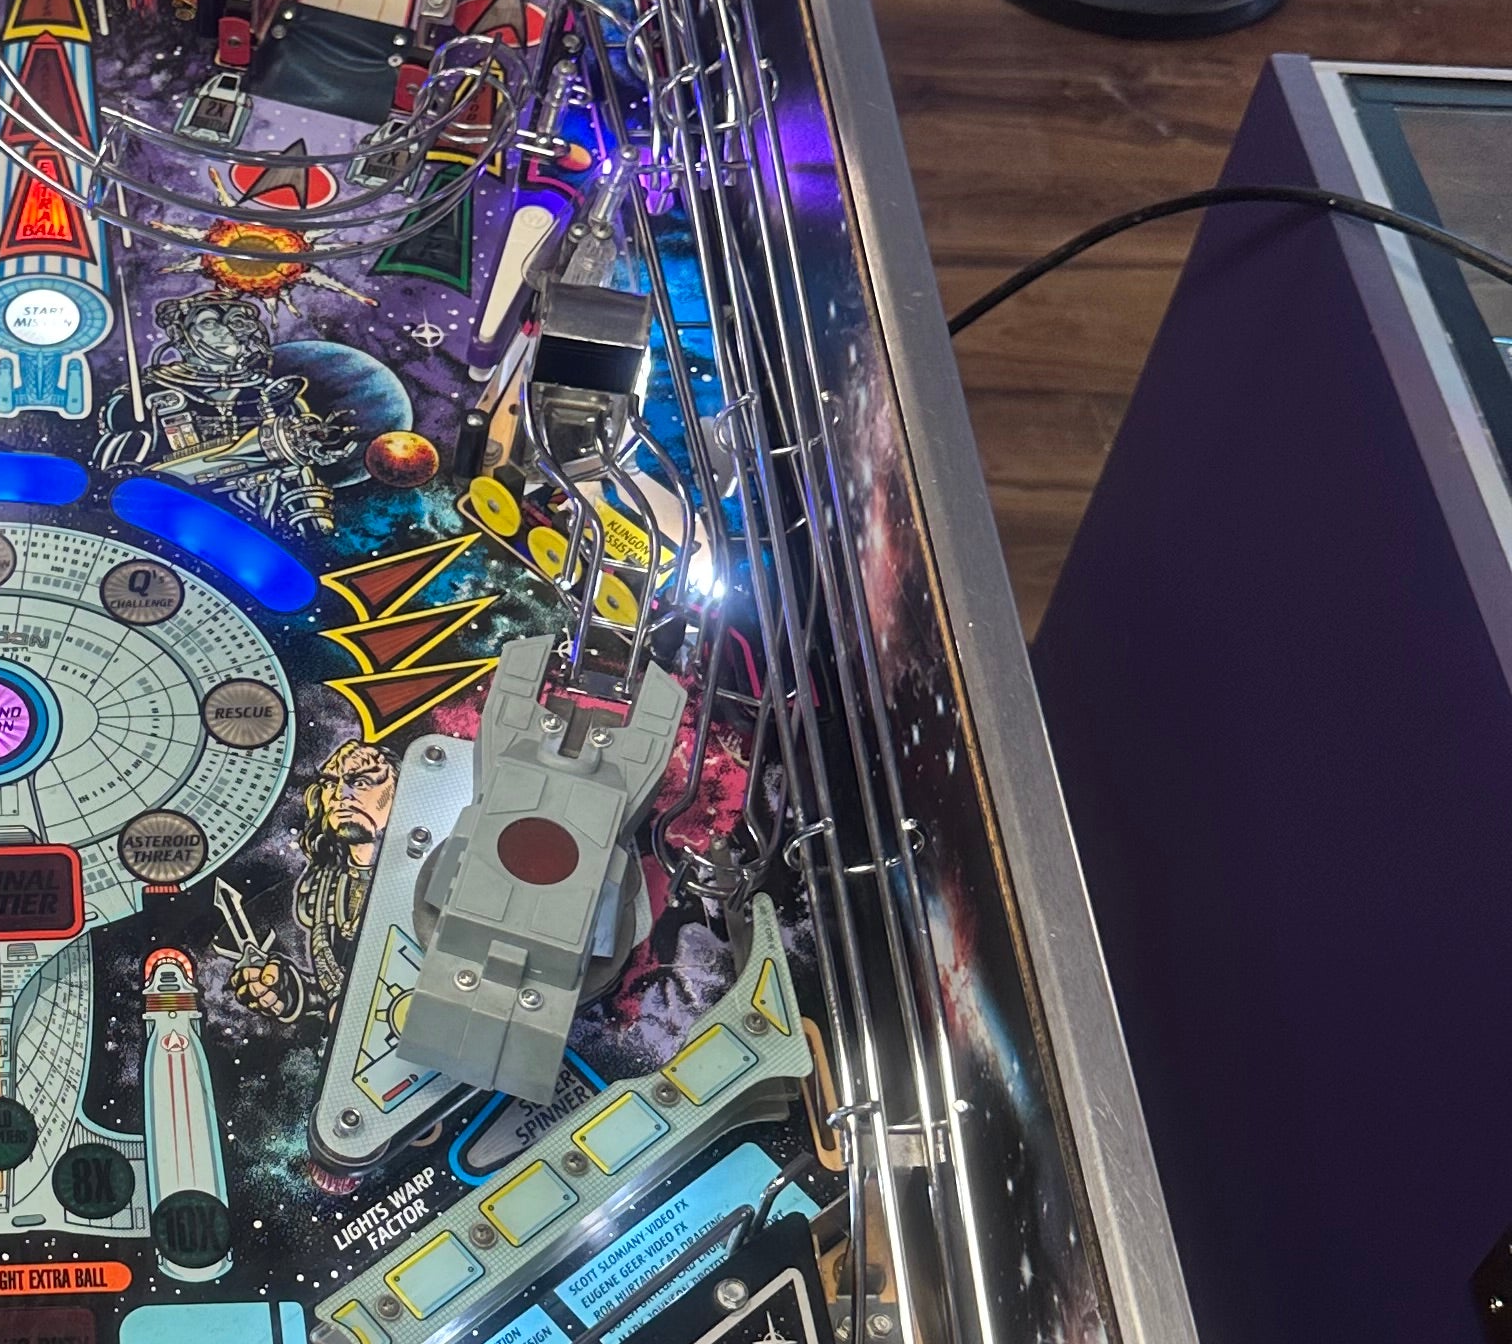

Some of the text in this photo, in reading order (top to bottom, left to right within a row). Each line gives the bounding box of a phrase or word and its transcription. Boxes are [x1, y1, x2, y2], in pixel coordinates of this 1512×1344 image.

[22, 224, 66, 237] BALL
[109, 596, 175, 610] CHALLENGE
[214, 704, 274, 720] RESCUE
[123, 833, 201, 849] ASTEROID
[131, 848, 196, 865] THREAT
[516, 1087, 590, 1146] SPINNER
[71, 1157, 116, 1203] 8X
[333, 1166, 436, 1252] LIGHTS WARP
[367, 1198, 429, 1251] FACTOR
[166, 1204, 224, 1254] 10X
[568, 1198, 689, 1296] SCOTT SLOMIANY-VIDEO FX
[29, 1266, 71, 1287] EXTRA
[75, 1266, 107, 1286] BALL
[580, 1222, 688, 1309] EUGENE GEER-VIDEO FX
[592, 1302, 616, 1323] ROB
